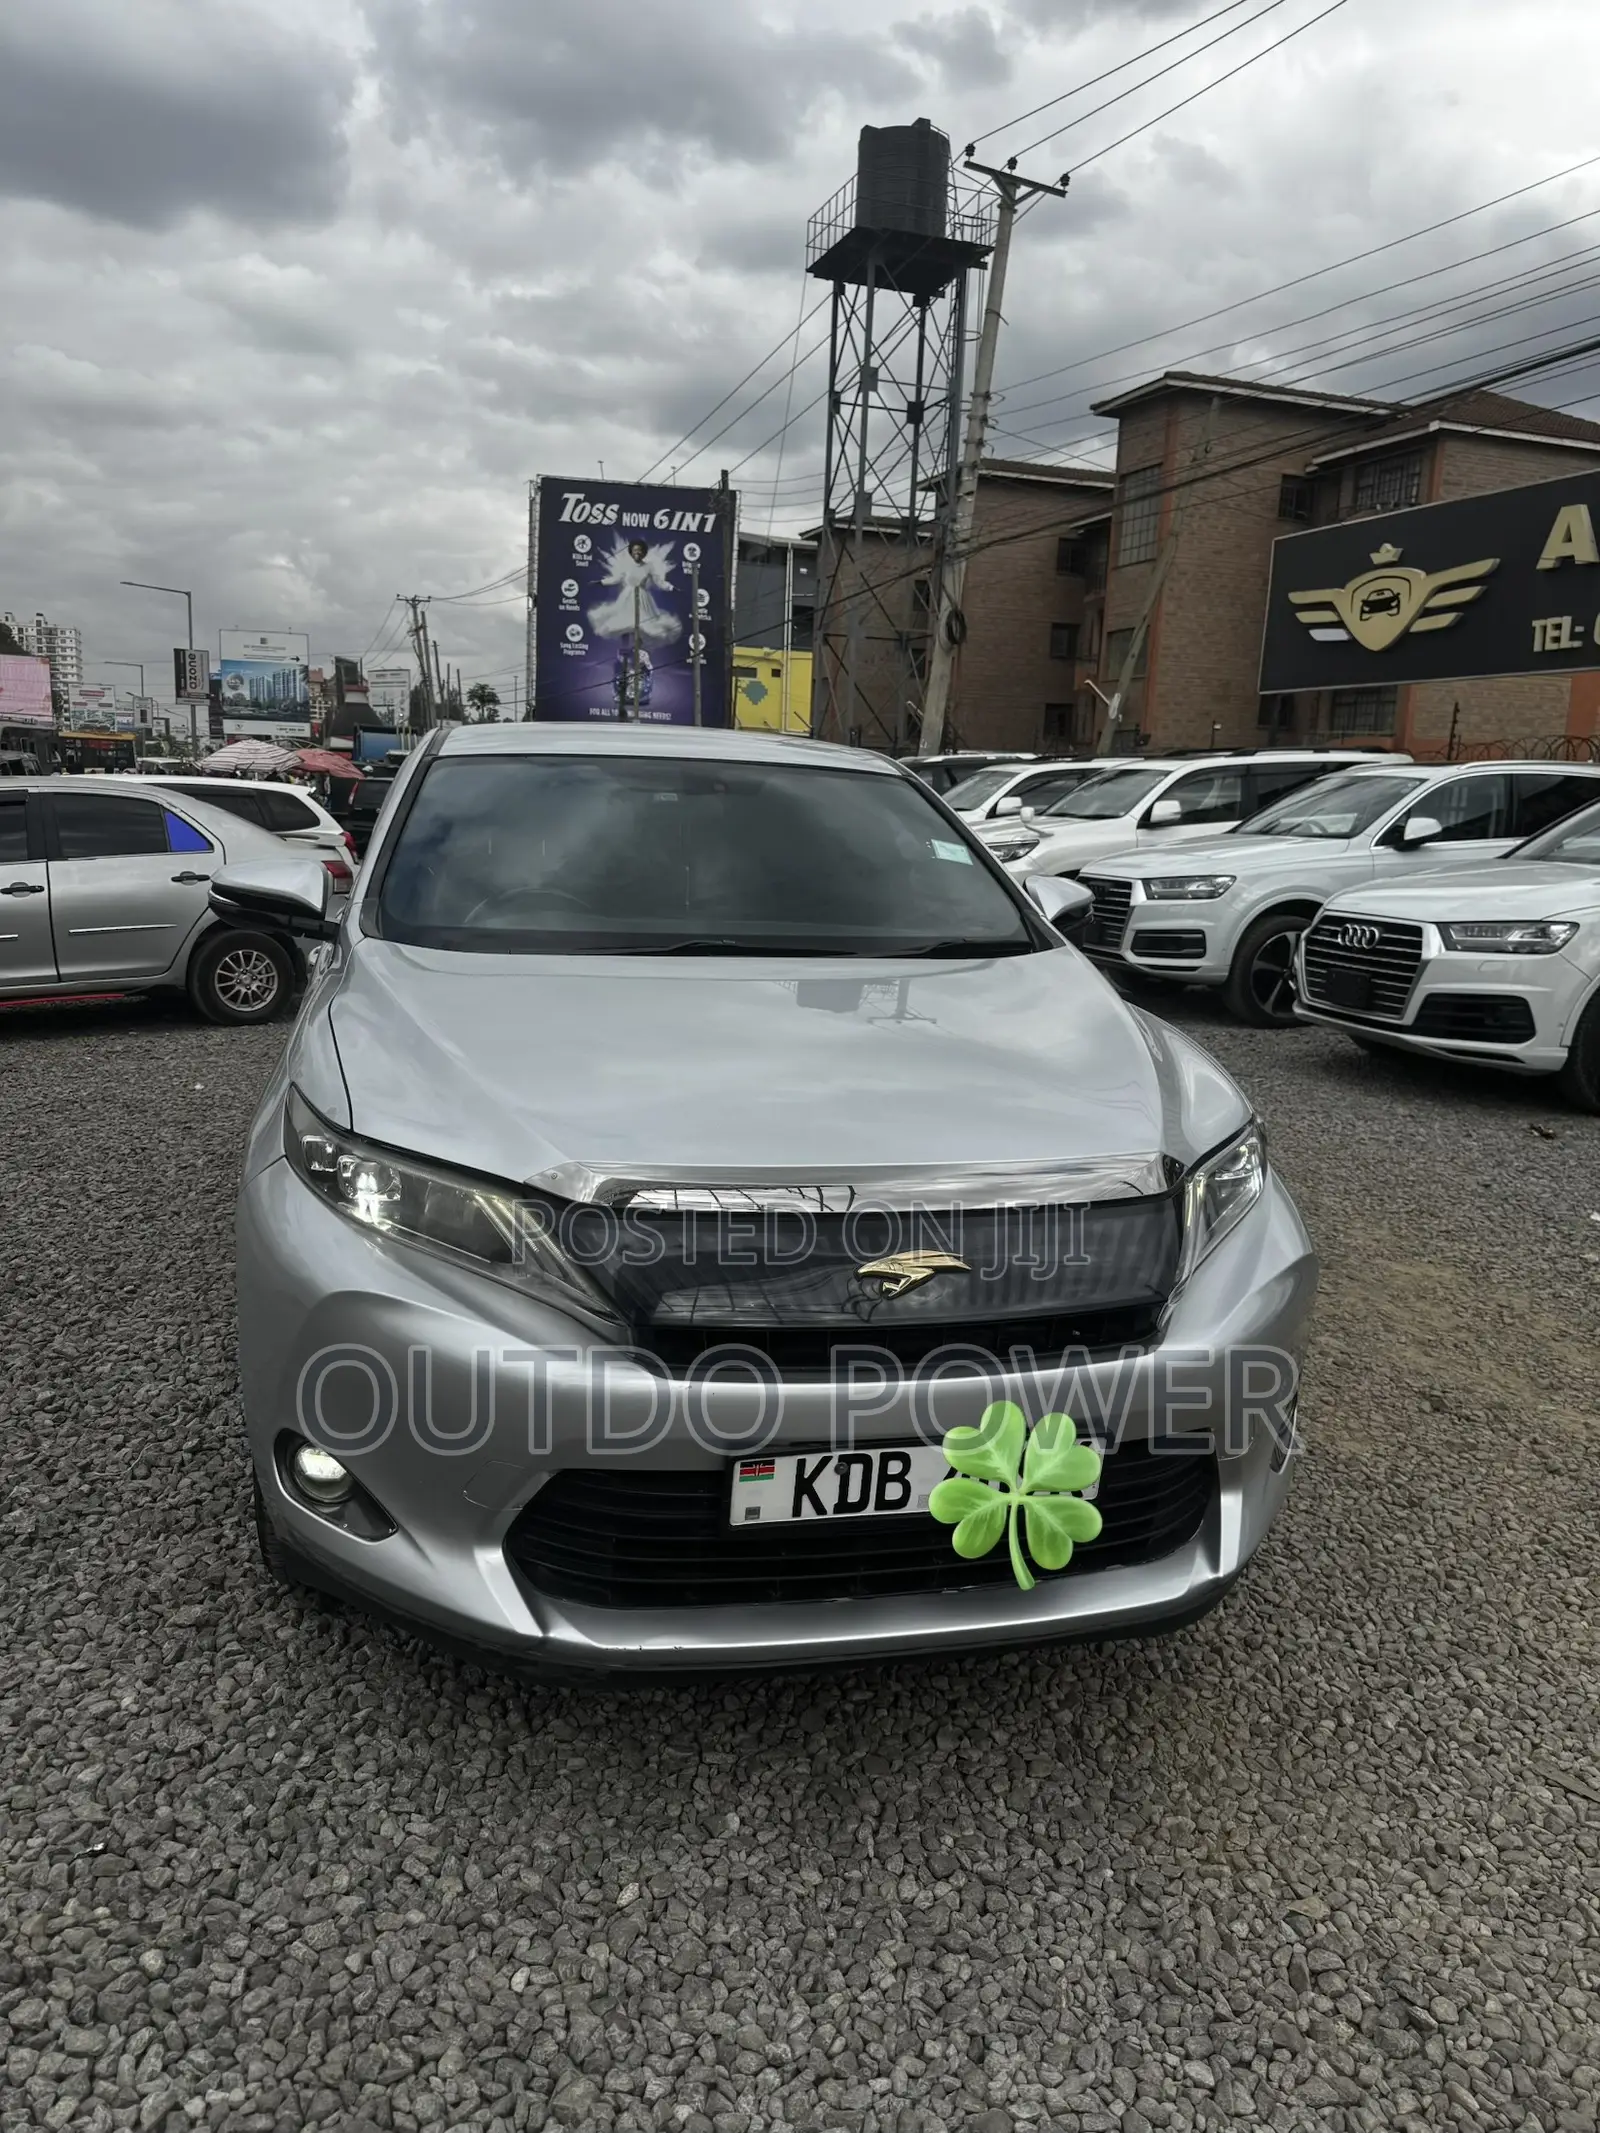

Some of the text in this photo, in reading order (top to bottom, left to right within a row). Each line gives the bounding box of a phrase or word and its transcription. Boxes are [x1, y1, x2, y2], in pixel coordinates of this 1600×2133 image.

[558, 492, 620, 526] Toss
[622, 512, 650, 528] NOW
[792, 1451, 911, 1518] KDB
